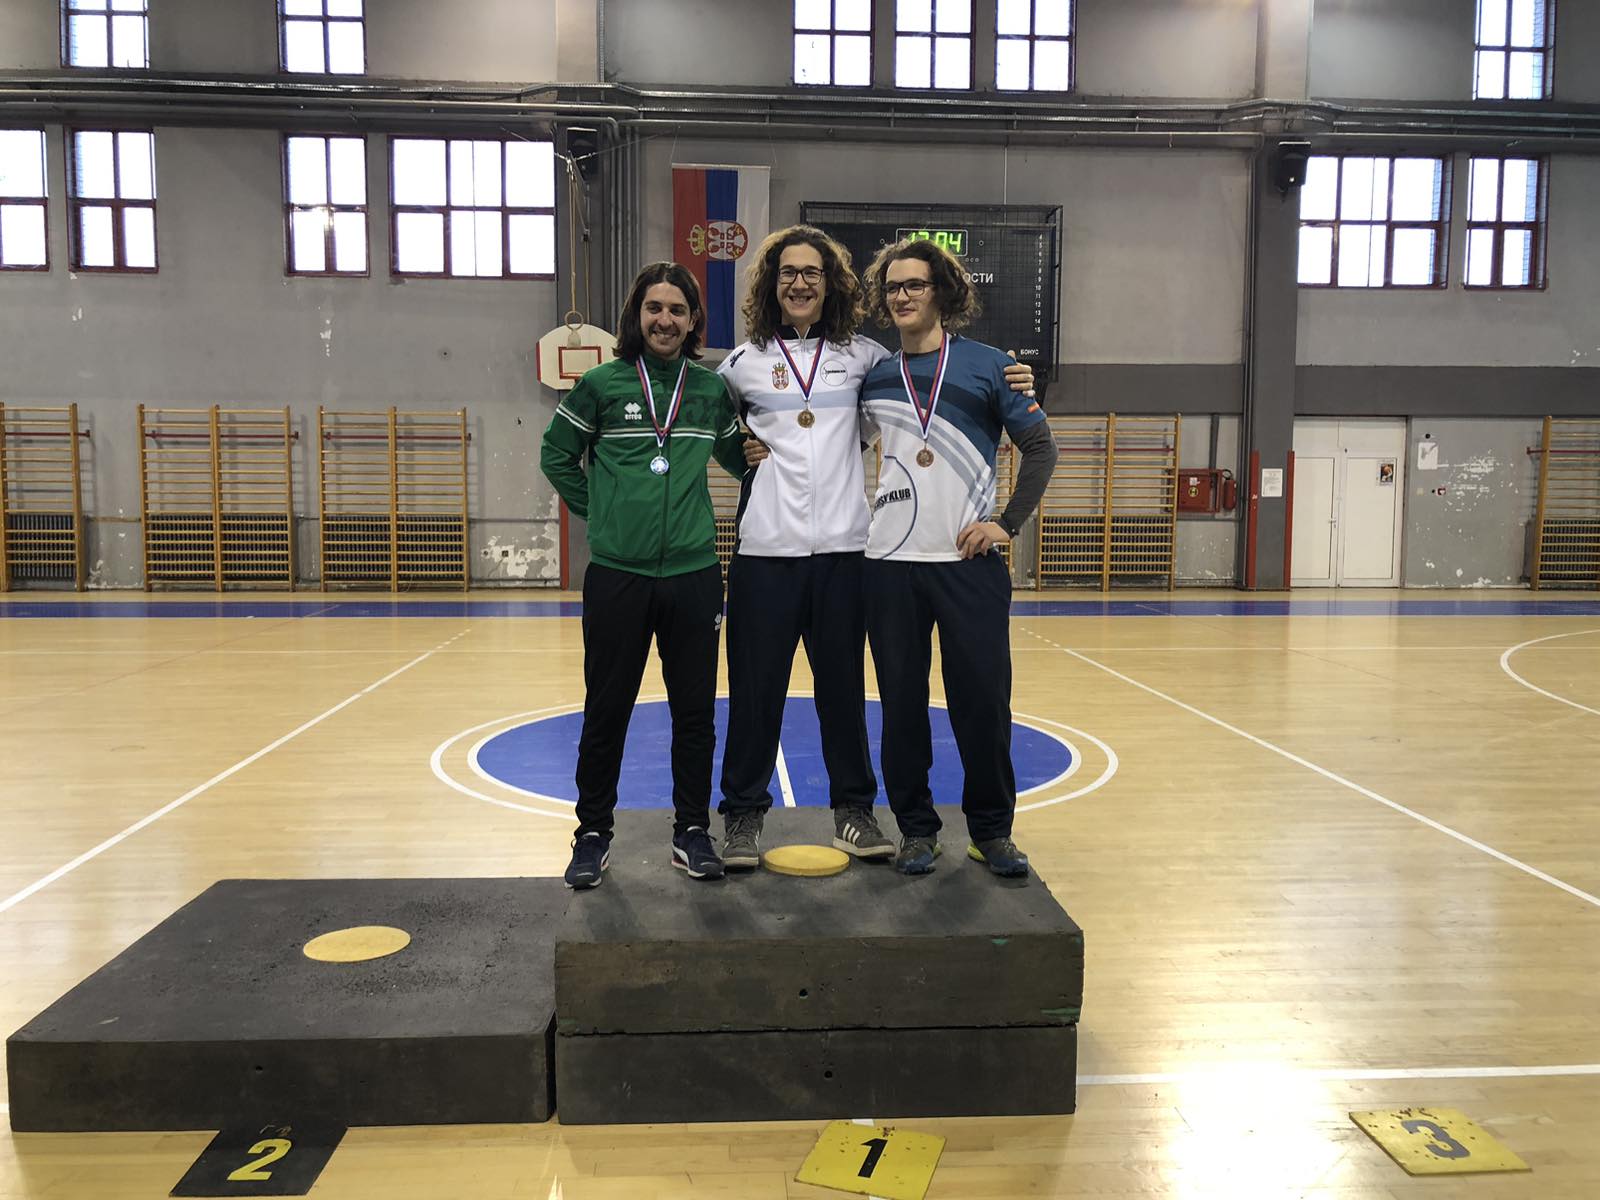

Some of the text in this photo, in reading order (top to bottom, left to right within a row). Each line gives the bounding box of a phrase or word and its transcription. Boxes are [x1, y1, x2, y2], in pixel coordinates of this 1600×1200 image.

[963, 272, 993, 283] ОСТИ
[857, 1138, 888, 1178] 1
[1401, 1120, 1470, 1158] 3
[226, 1138, 292, 1181] 2
